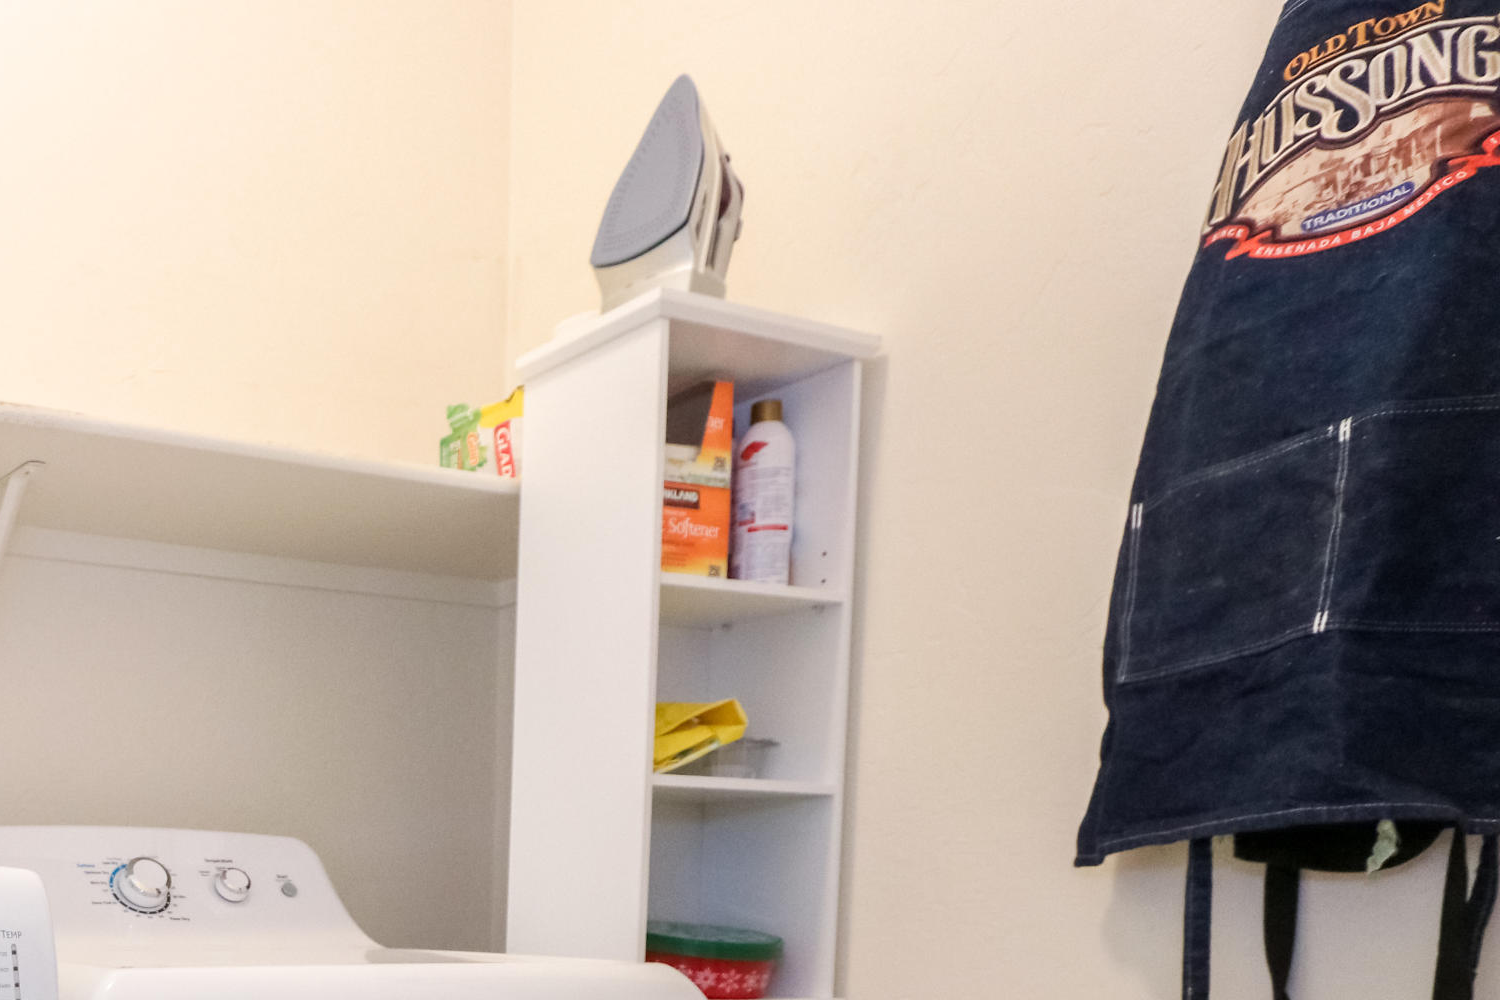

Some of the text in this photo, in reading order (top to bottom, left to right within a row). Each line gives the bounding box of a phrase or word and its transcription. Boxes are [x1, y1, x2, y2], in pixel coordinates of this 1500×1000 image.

[1255, 171, 1468, 257] ENSENADA BAJA MEXICO
[1303, 185, 1412, 230] TRADITIONAL
[668, 517, 721, 539] Softener
[1, 930, 22, 939] TEMP
